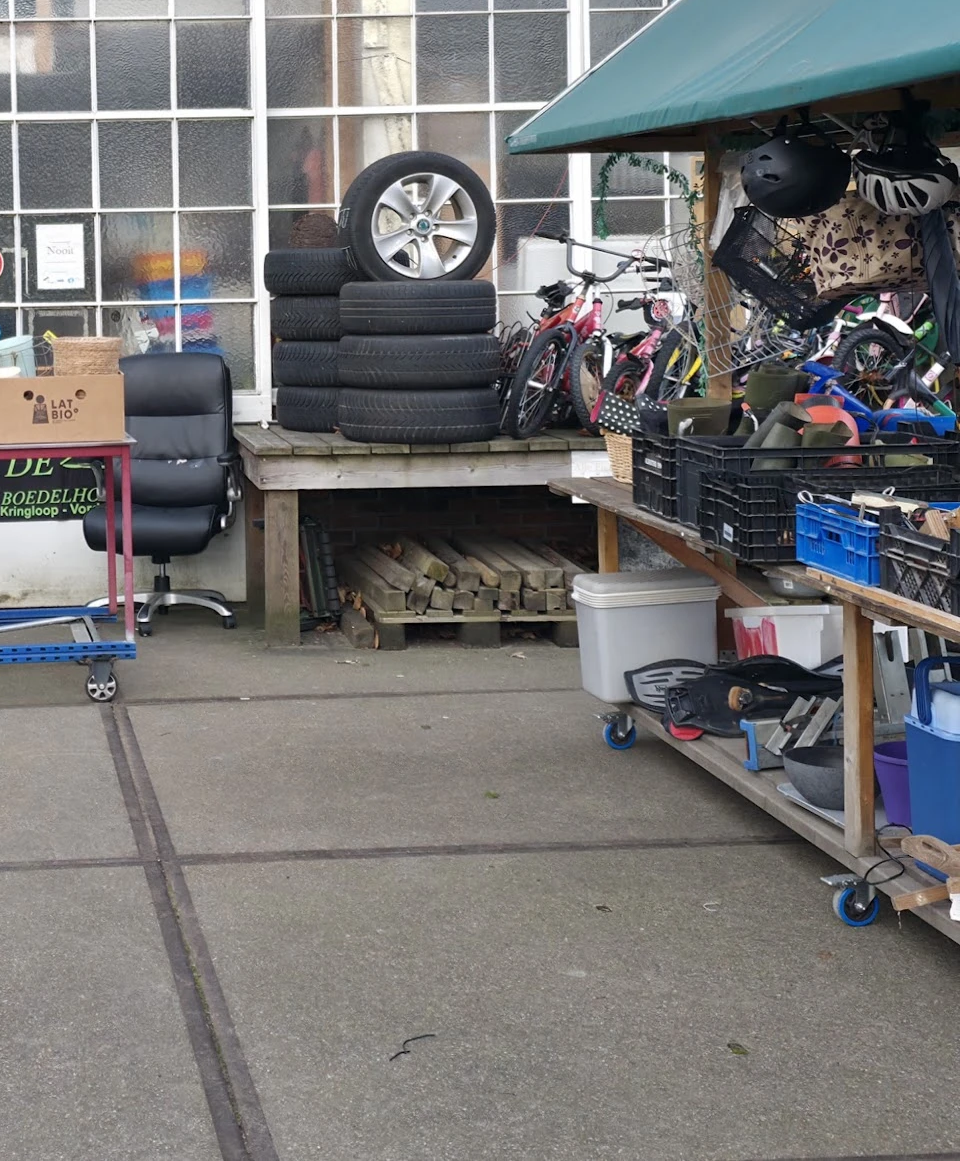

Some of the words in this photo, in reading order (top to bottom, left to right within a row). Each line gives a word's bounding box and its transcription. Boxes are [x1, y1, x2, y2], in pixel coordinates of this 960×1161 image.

[51, 399, 73, 409] LAT
[4, 457, 54, 478] DE
[1, 487, 100, 506] BOEDELHO
[0, 505, 59, 519] Kringloop
